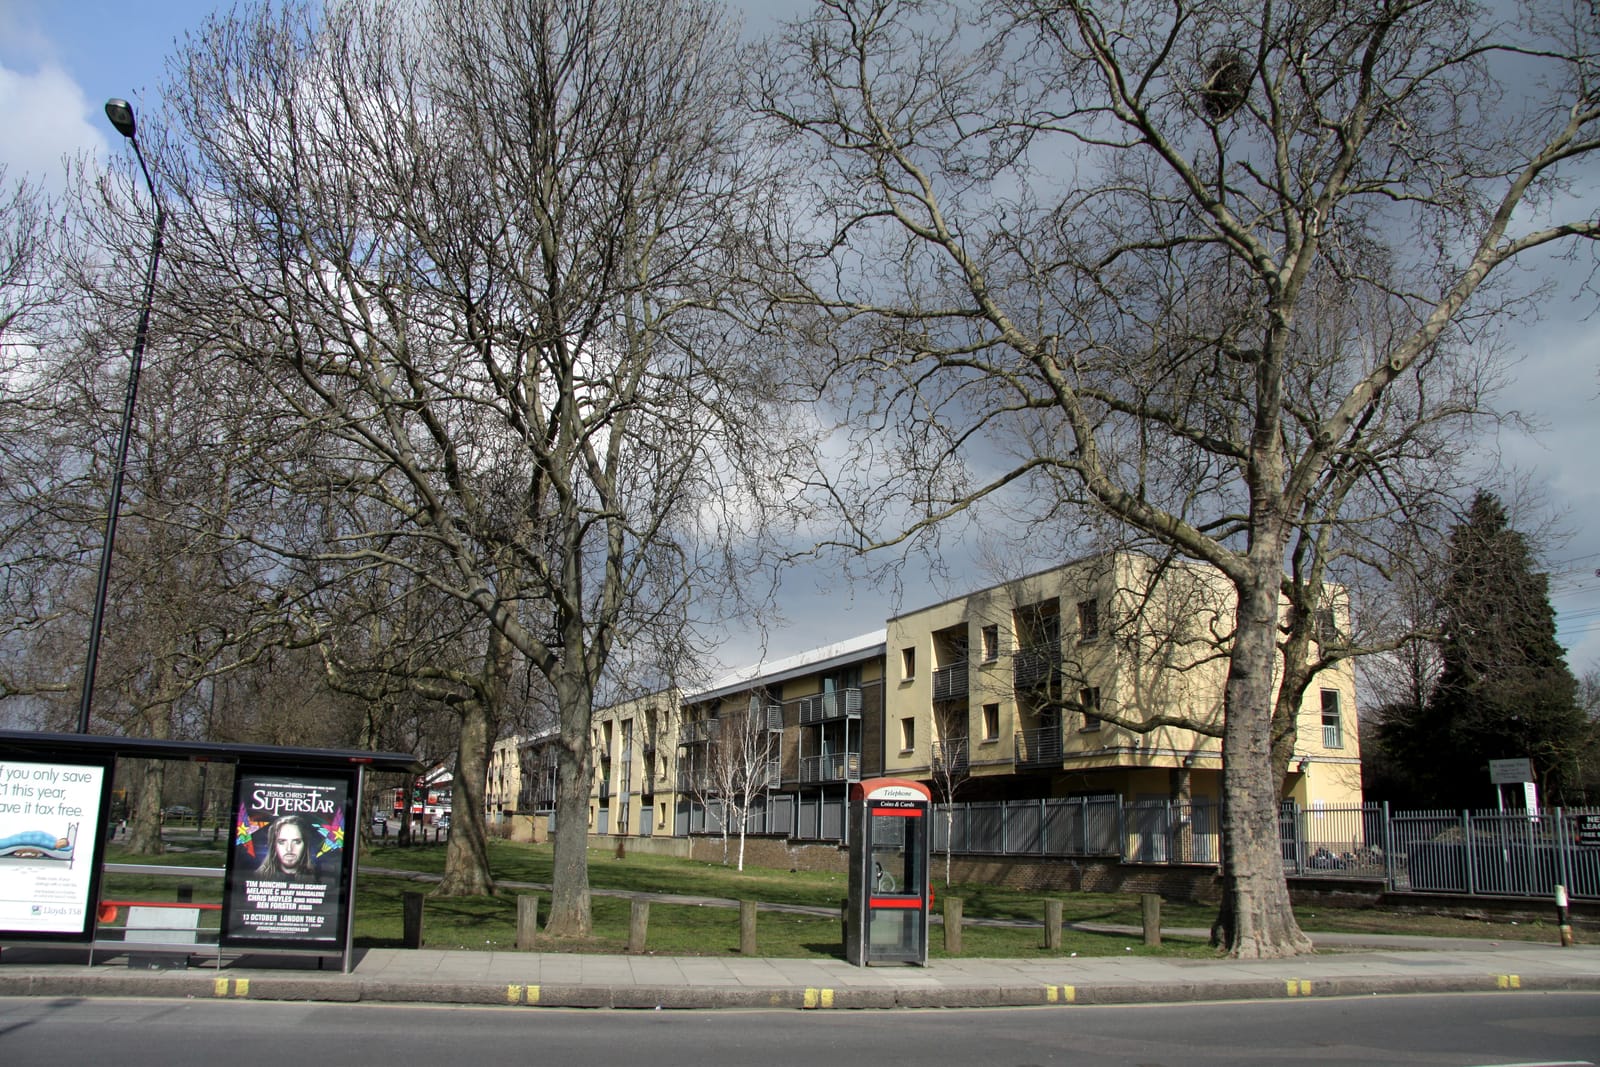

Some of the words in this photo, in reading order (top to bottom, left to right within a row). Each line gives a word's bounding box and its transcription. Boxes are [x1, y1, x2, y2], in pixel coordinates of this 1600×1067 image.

[7, 769, 30, 782] you
[33, 768, 60, 784] only
[62, 772, 92, 783] save
[0, 783, 8, 796] 1
[12, 783, 34, 797] this
[38, 787, 66, 800] year,
[285, 791, 307, 799] CHRIST
[252, 789, 334, 816] SUPERSTAR
[0, 803, 21, 814] ave
[24, 801, 32, 814] it
[35, 802, 55, 815] tax
[58, 802, 84, 816] free.
[246, 880, 258, 888] TIM
[259, 881, 287, 889] MINCHIN
[246, 887, 274, 895] MELANIE
[247, 894, 267, 902] CHRIS
[267, 895, 292, 903] MOYLES
[256, 901, 269, 909] BEN
[43, 906, 67, 916] Lloyds
[280, 914, 304, 922] LONDON
[305, 915, 316, 923] THE
